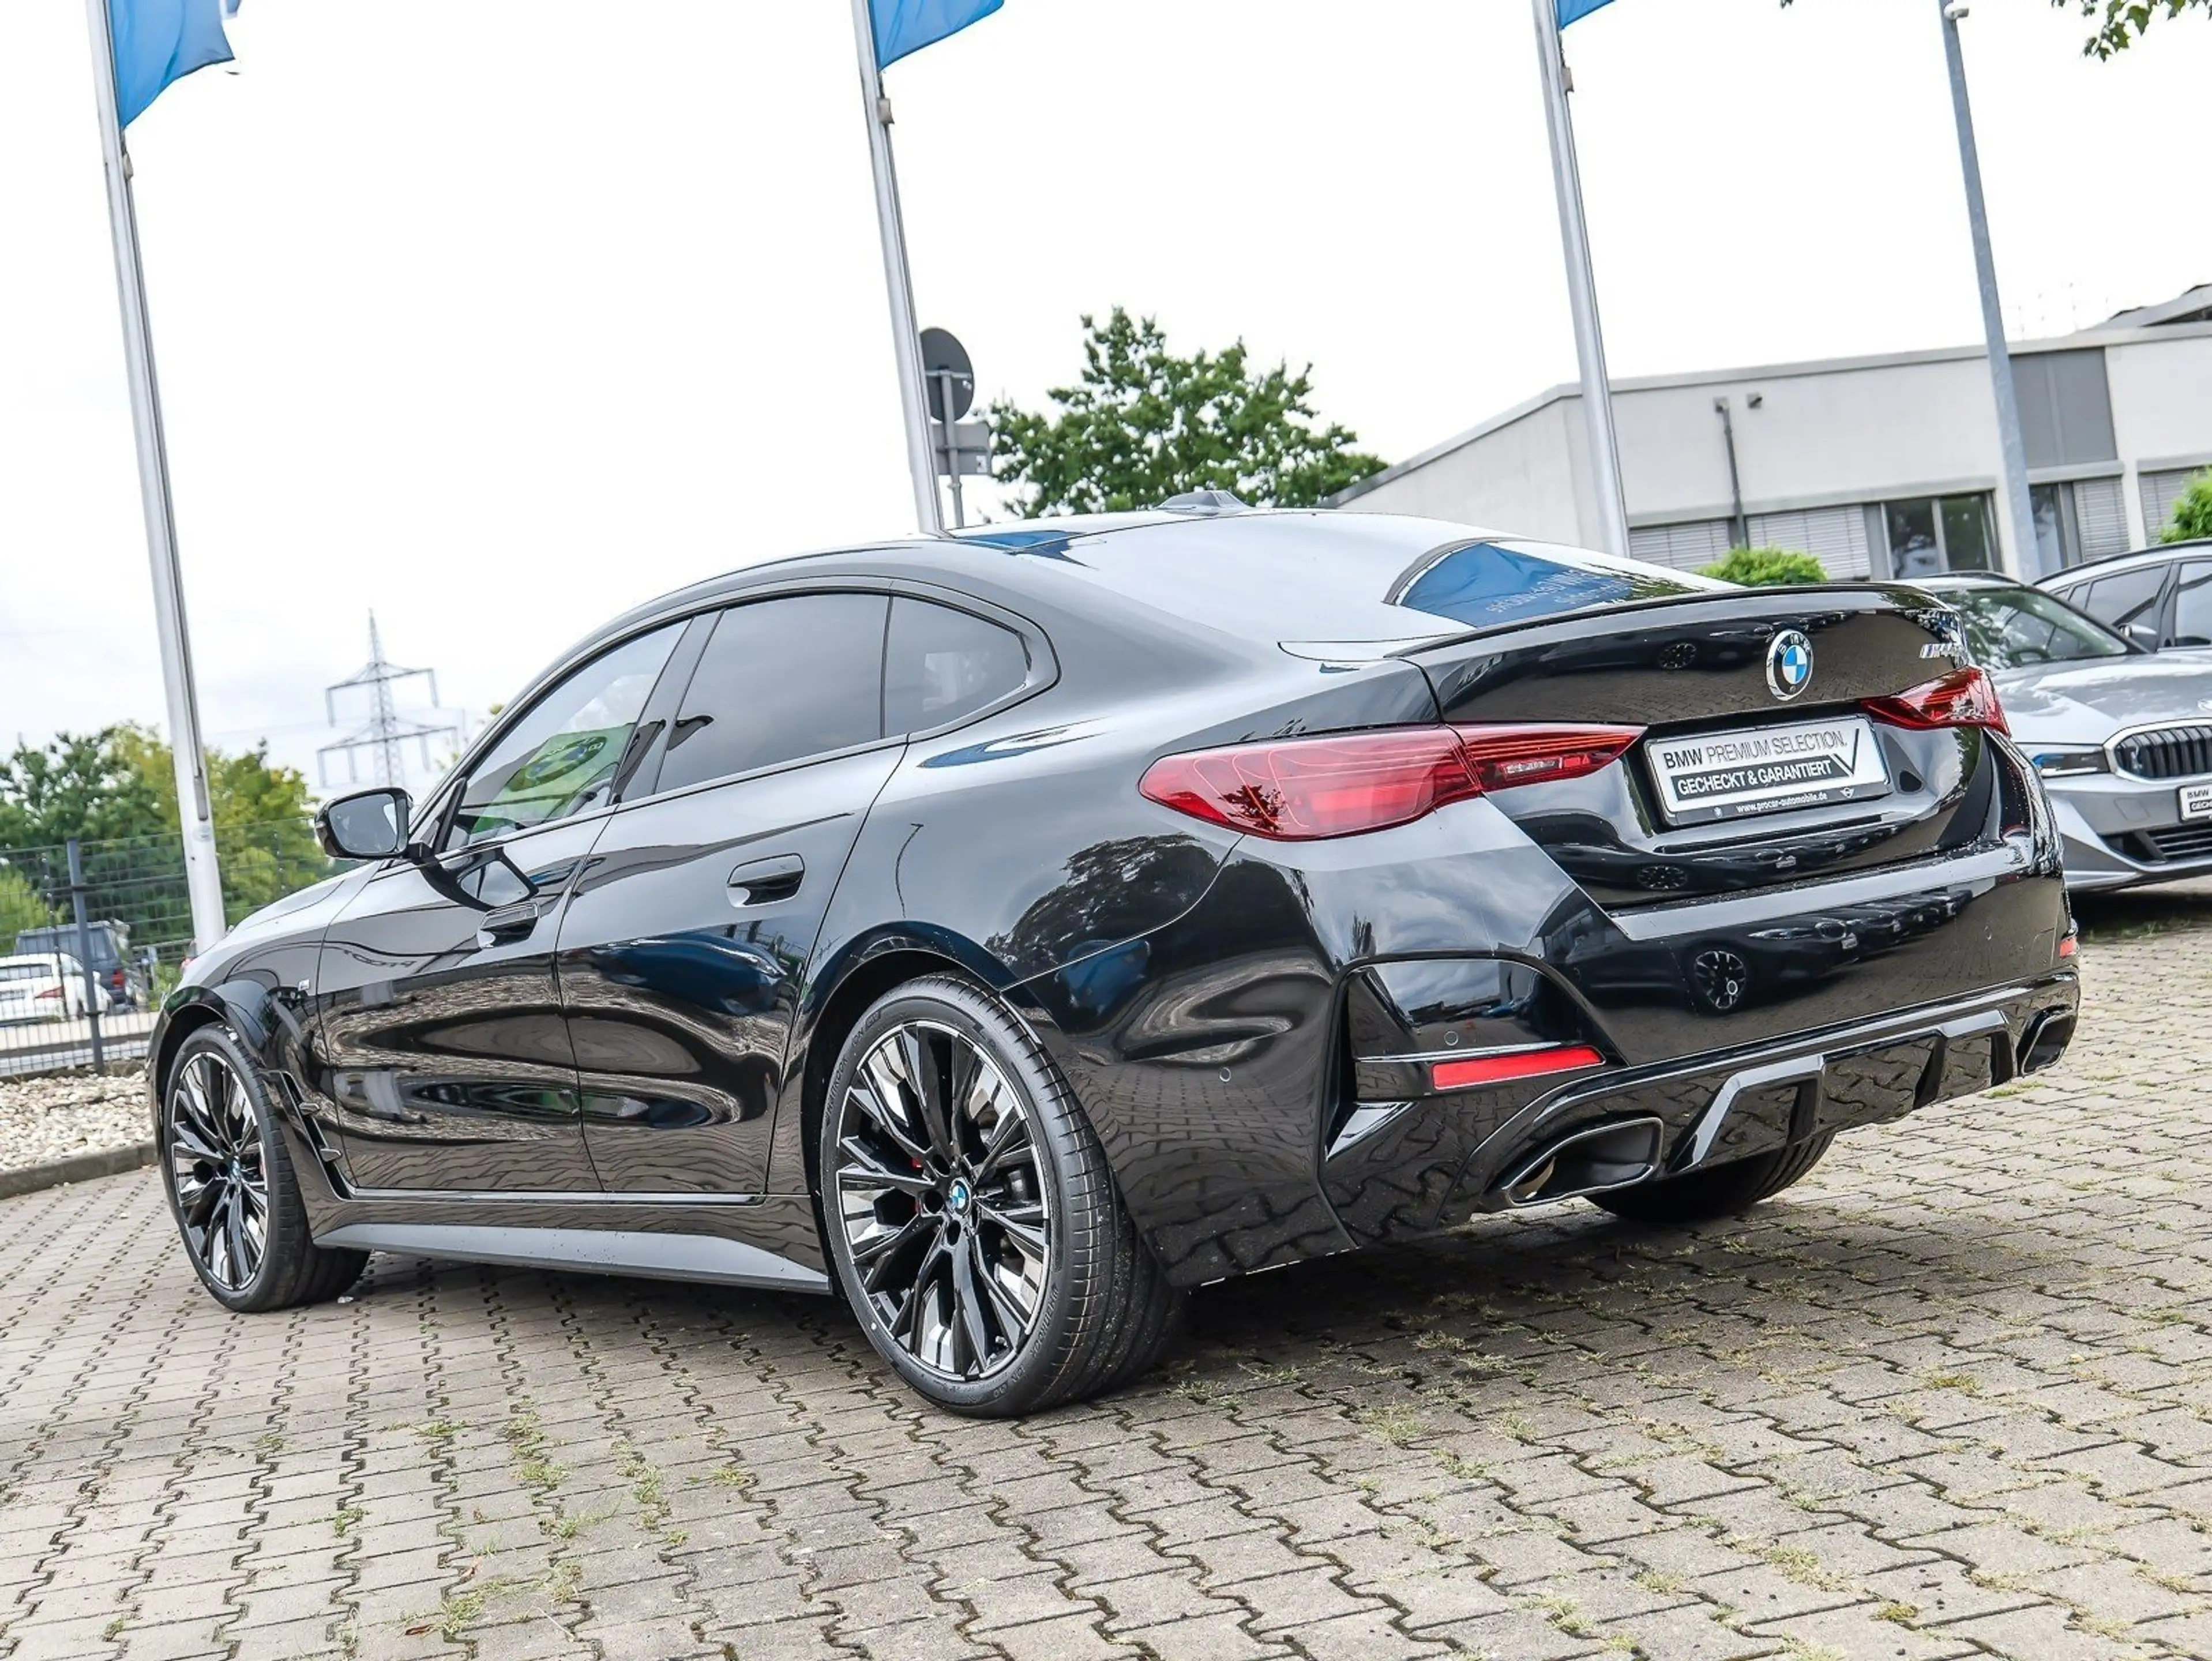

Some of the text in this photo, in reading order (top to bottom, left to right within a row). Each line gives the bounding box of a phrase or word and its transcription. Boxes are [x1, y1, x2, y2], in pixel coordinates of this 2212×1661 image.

[1663, 748, 1702, 769] BMW
[1706, 740, 1771, 764] PREMIUM
[1678, 759, 1832, 795] GECHECKT & GARANTIERT
[1736, 792, 1827, 812] www.procar-automobile.de
[2187, 789, 2209, 799] BMW
